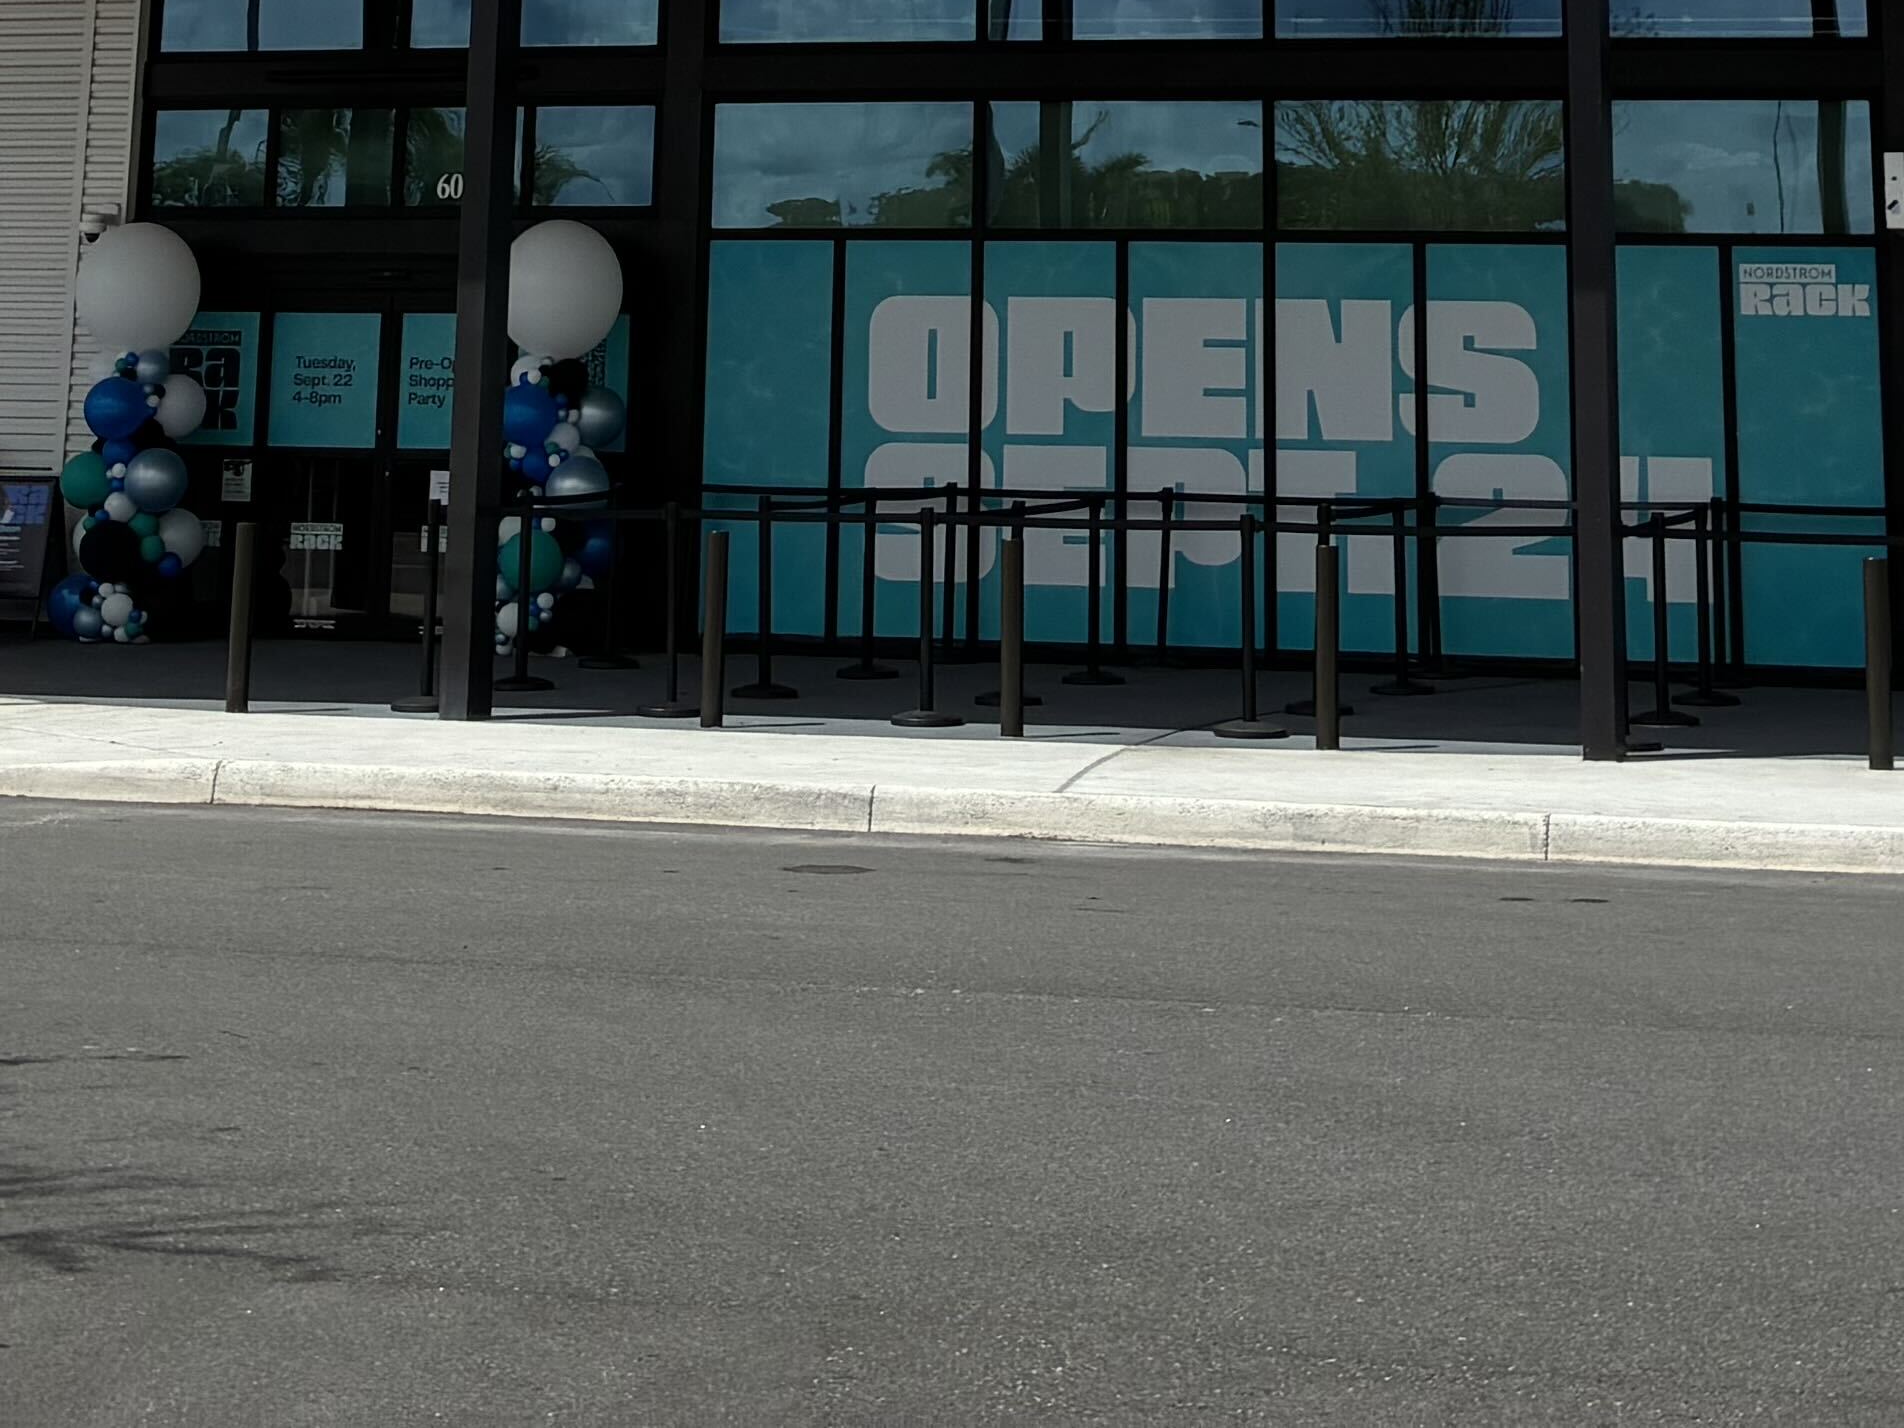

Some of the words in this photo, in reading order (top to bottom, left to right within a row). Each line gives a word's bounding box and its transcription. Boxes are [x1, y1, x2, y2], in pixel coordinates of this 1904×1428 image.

[1743, 266, 1832, 280] NORDSTROM
[295, 355, 357, 372] Tuesday,
[409, 356, 455, 370] Pre-O
[868, 294, 1539, 444] OPENS
[333, 374, 353, 387] 22
[407, 392, 446, 409] Party
